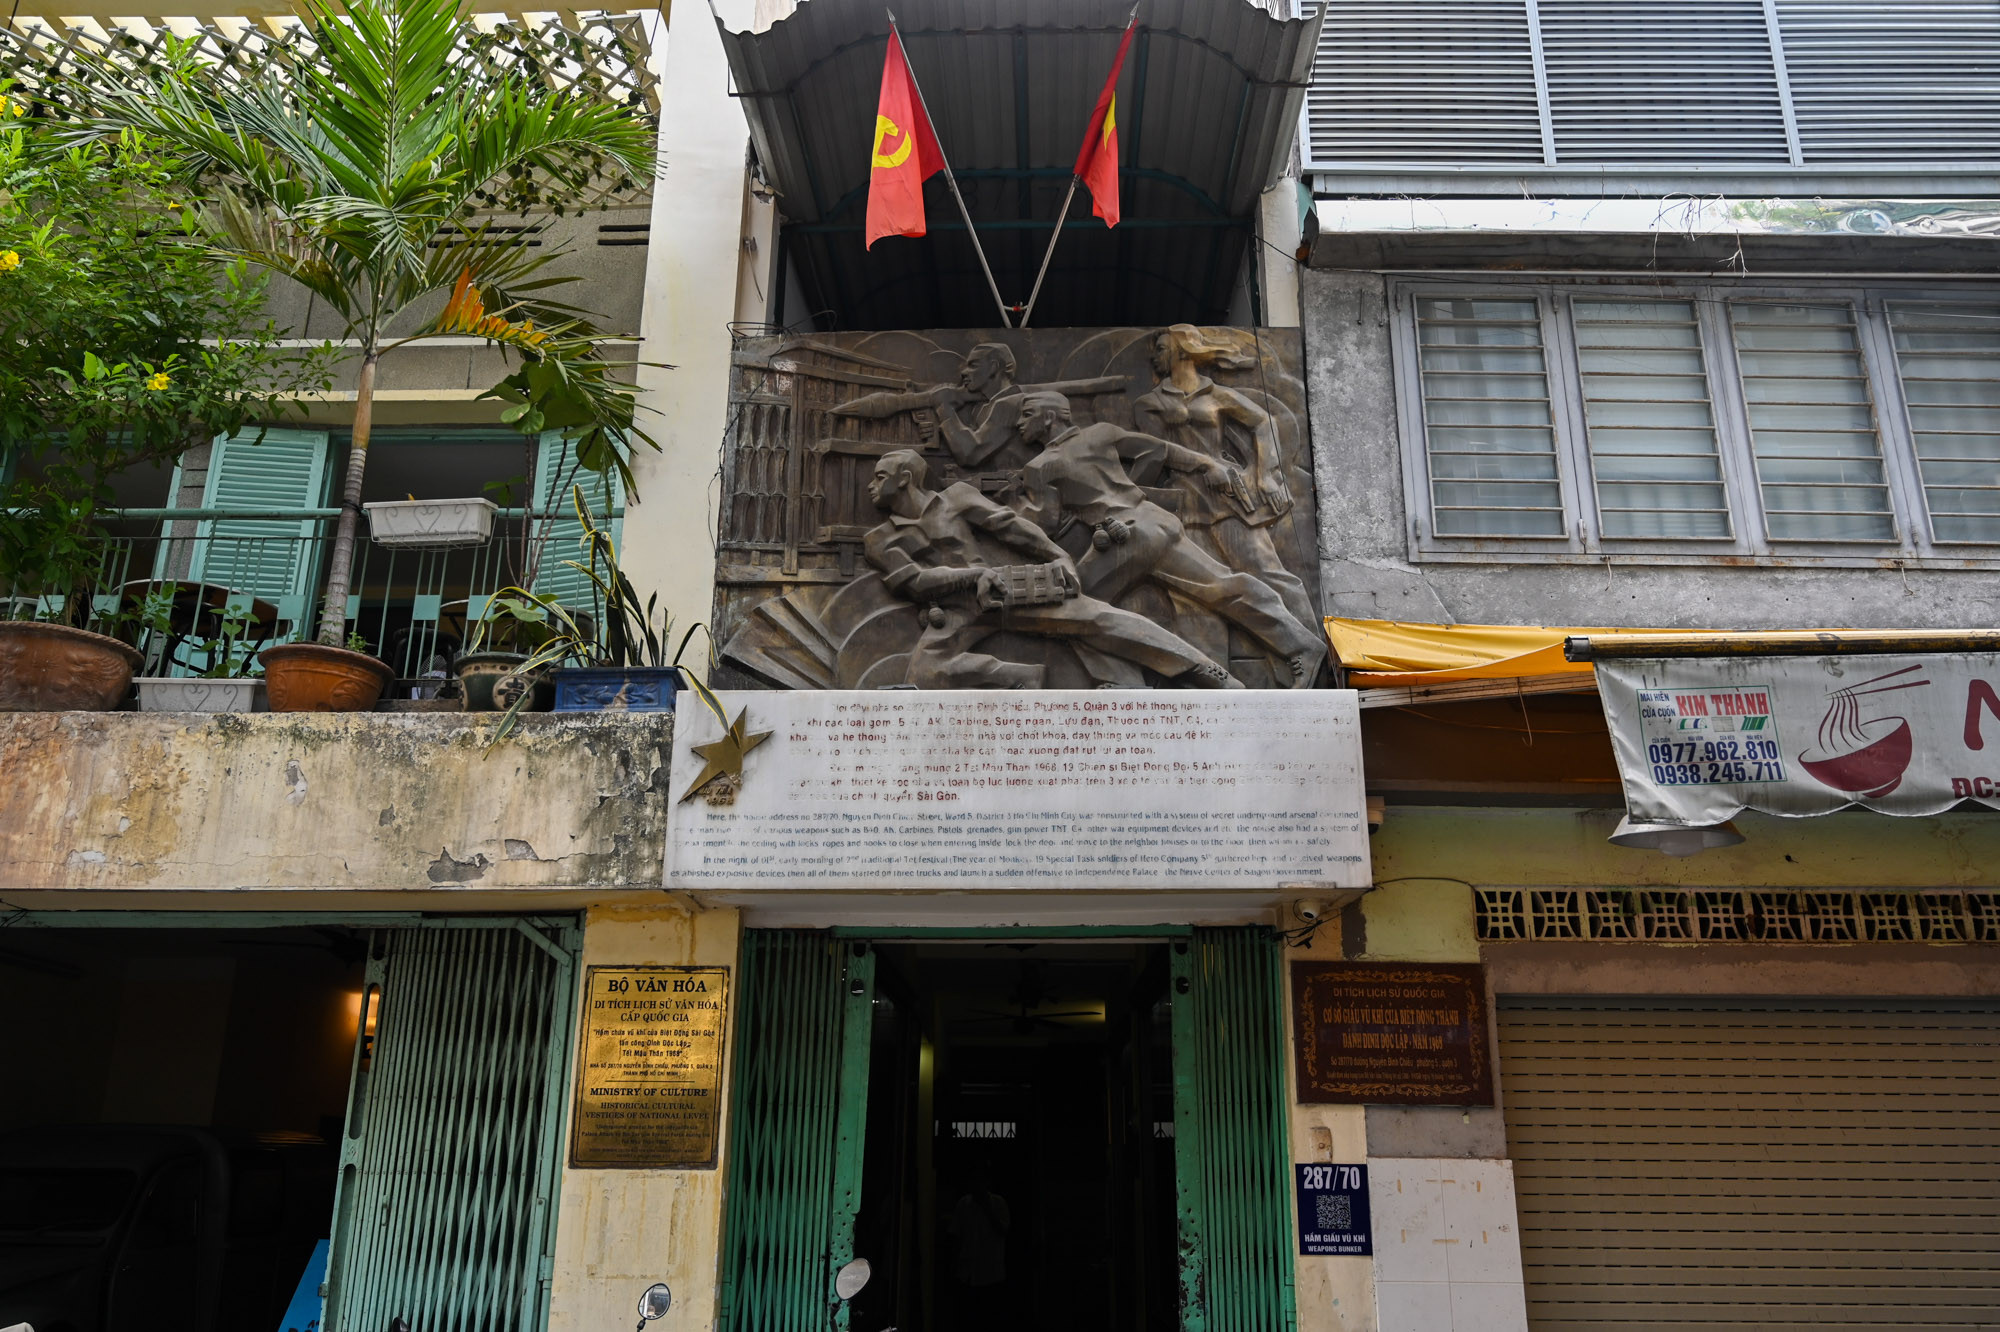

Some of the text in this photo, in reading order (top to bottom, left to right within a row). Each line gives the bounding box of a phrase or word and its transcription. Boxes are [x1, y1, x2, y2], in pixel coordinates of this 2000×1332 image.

[1112, 702, 1117, 710] 3
[1676, 688, 1769, 716] KIM THÀNH
[1642, 705, 1676, 718] CỬA CUỐN
[1649, 740, 1778, 764] 0977.962.810
[1654, 762, 1782, 784] 0938.245.711
[1128, 826, 1169, 834] equipment
[1046, 856, 1074, 864] Special
[1161, 855, 1198, 864] Company
[608, 976, 707, 994] BỘ VĂN HÓA
[1334, 988, 1342, 996] DI
[594, 998, 718, 1010] DI TÍCH LỊCH SỬ VĂN HÓA
[620, 1010, 689, 1023] CẤP QUỐC GIA
[660, 1088, 708, 1096] CULTURE
[1303, 1166, 1360, 1191] 287/70
[1323, 1232, 1340, 1242] GIẤU
[1342, 1233, 1351, 1242] VŨ
[1353, 1233, 1366, 1242] KHÍ
